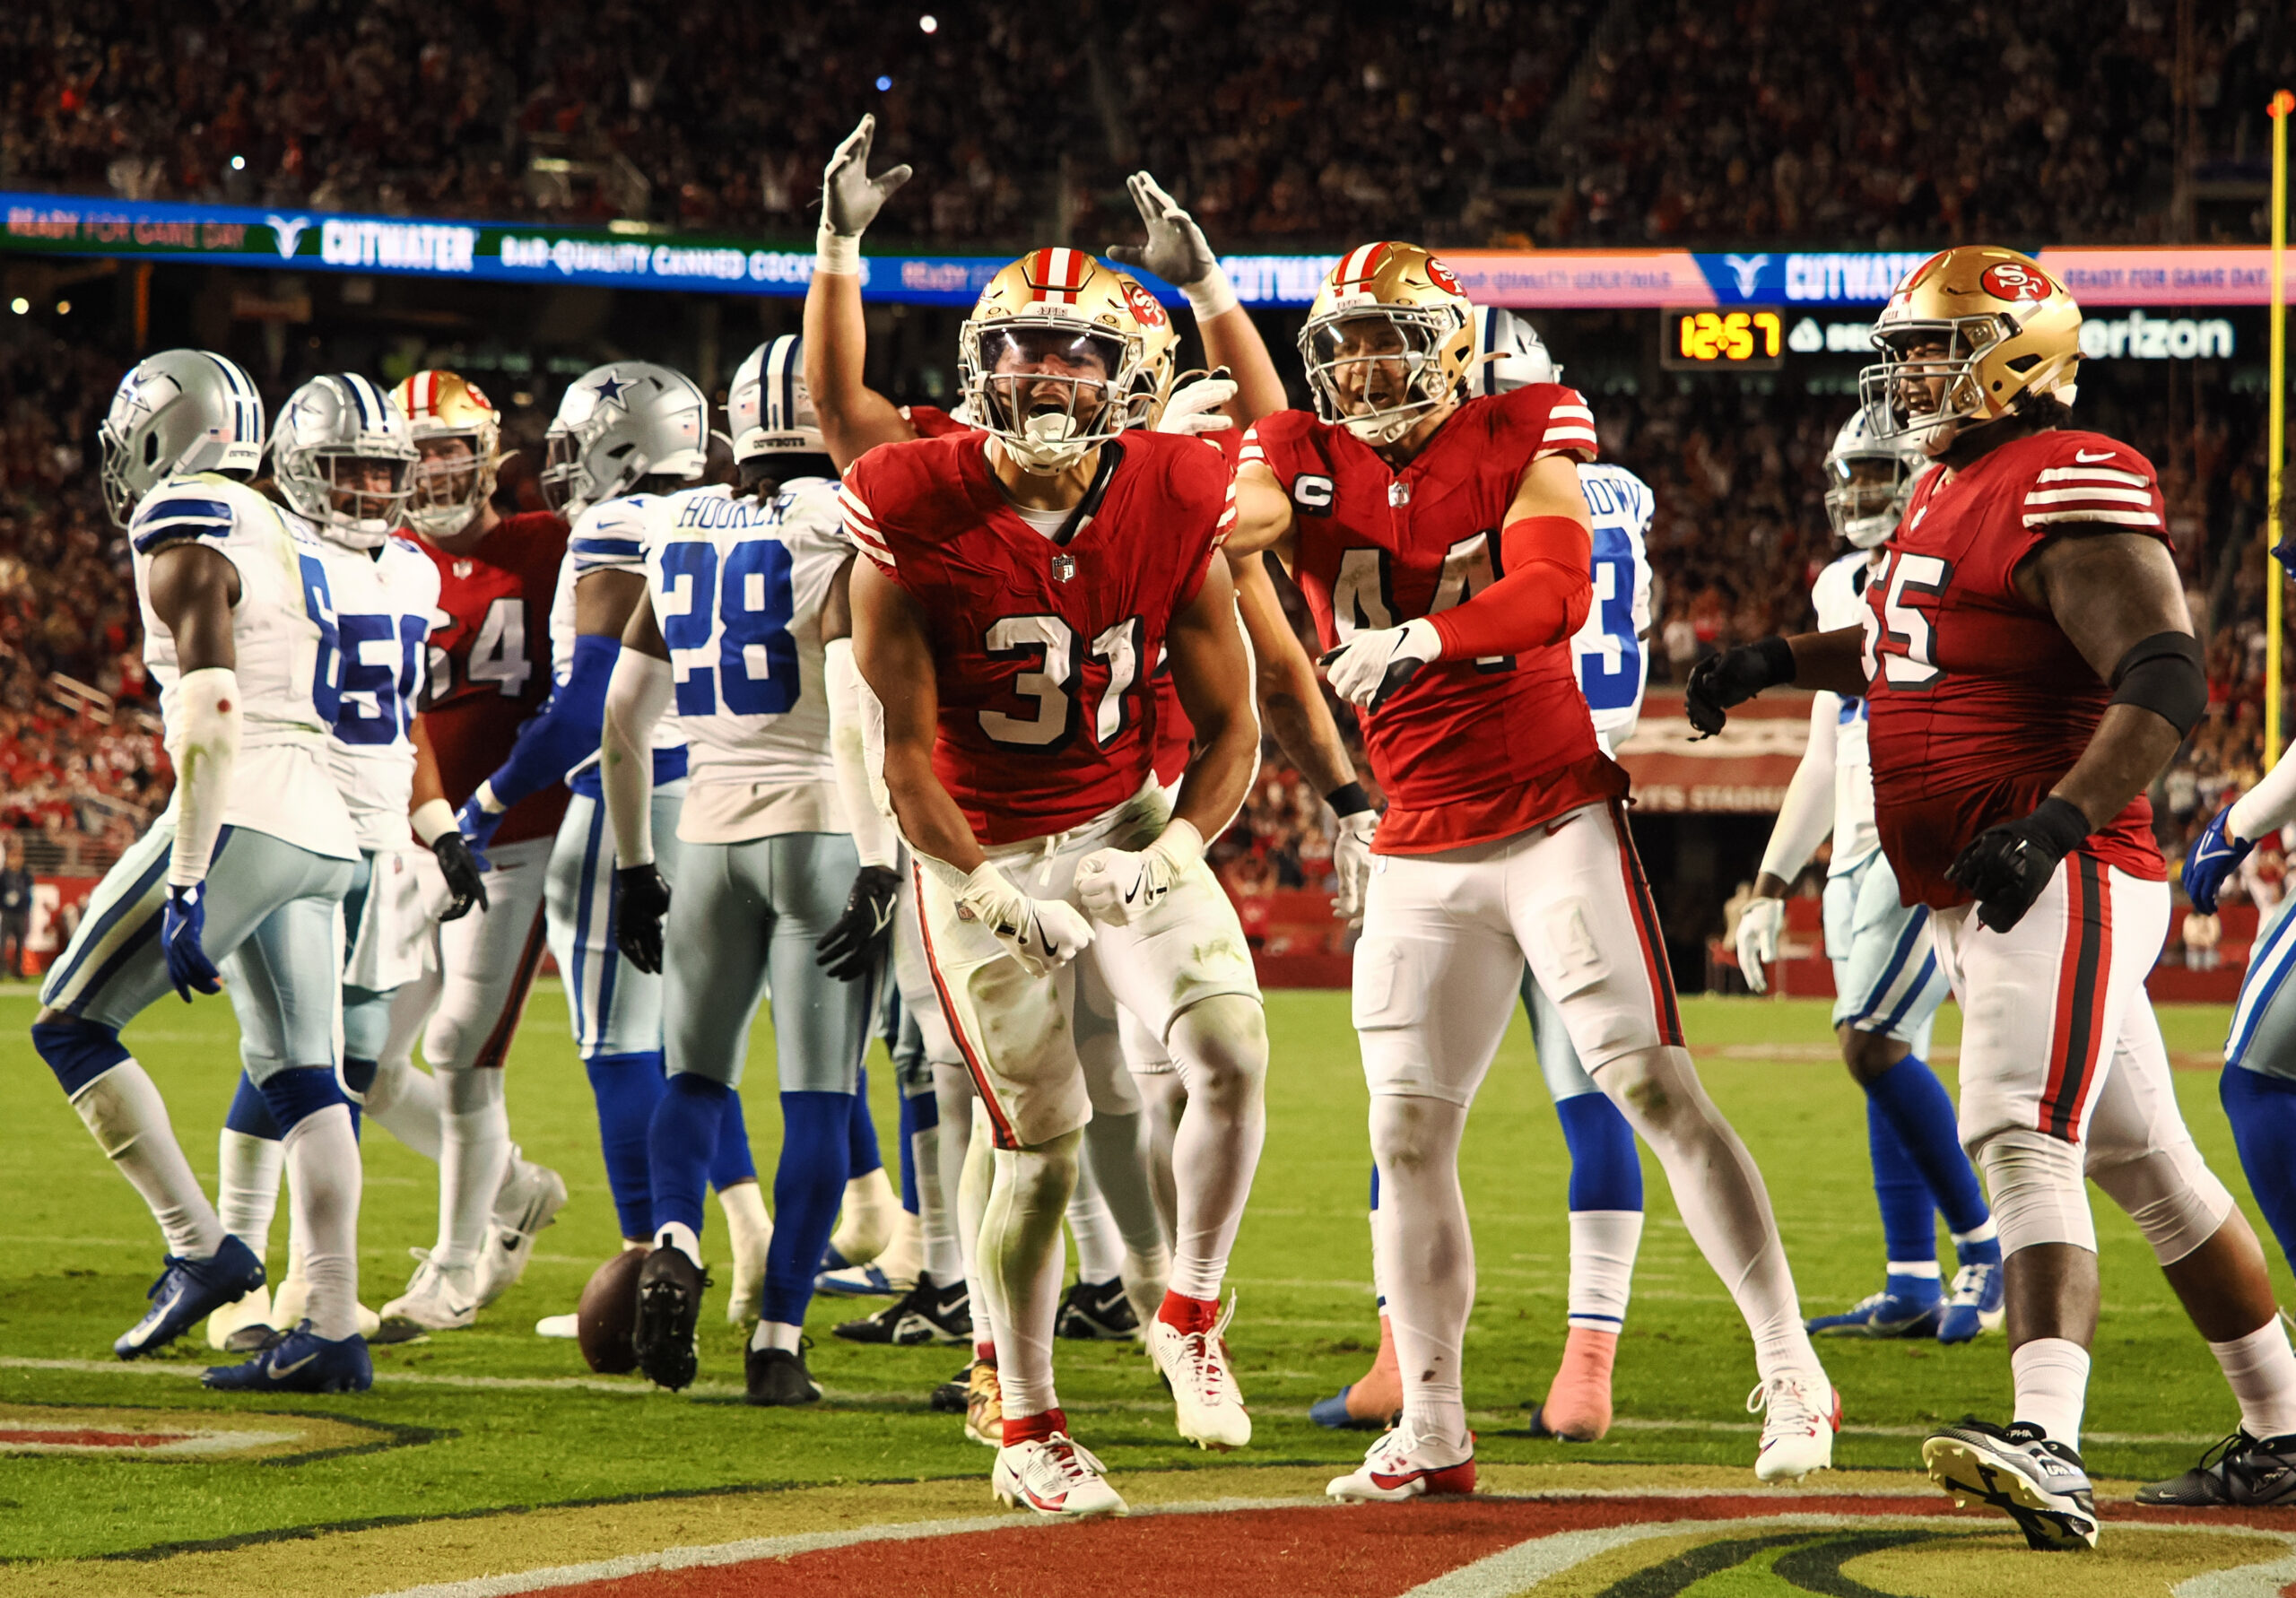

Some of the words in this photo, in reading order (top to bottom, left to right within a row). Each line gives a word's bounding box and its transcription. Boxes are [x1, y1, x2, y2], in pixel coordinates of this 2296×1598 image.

[321, 219, 474, 273] CUTWATER
[653, 245, 746, 281] CANNED
[1220, 255, 1345, 302] CUTWAT
[1786, 252, 1928, 300] CUTWAT
[1681, 311, 1780, 360] 12:57
[2079, 310, 2233, 360] erizon
[676, 493, 797, 529] HOOKER
[1294, 475, 1334, 508] C
[660, 539, 803, 716] 28
[978, 614, 1144, 750] 31
[2006, 1429, 2035, 1439] PHA
